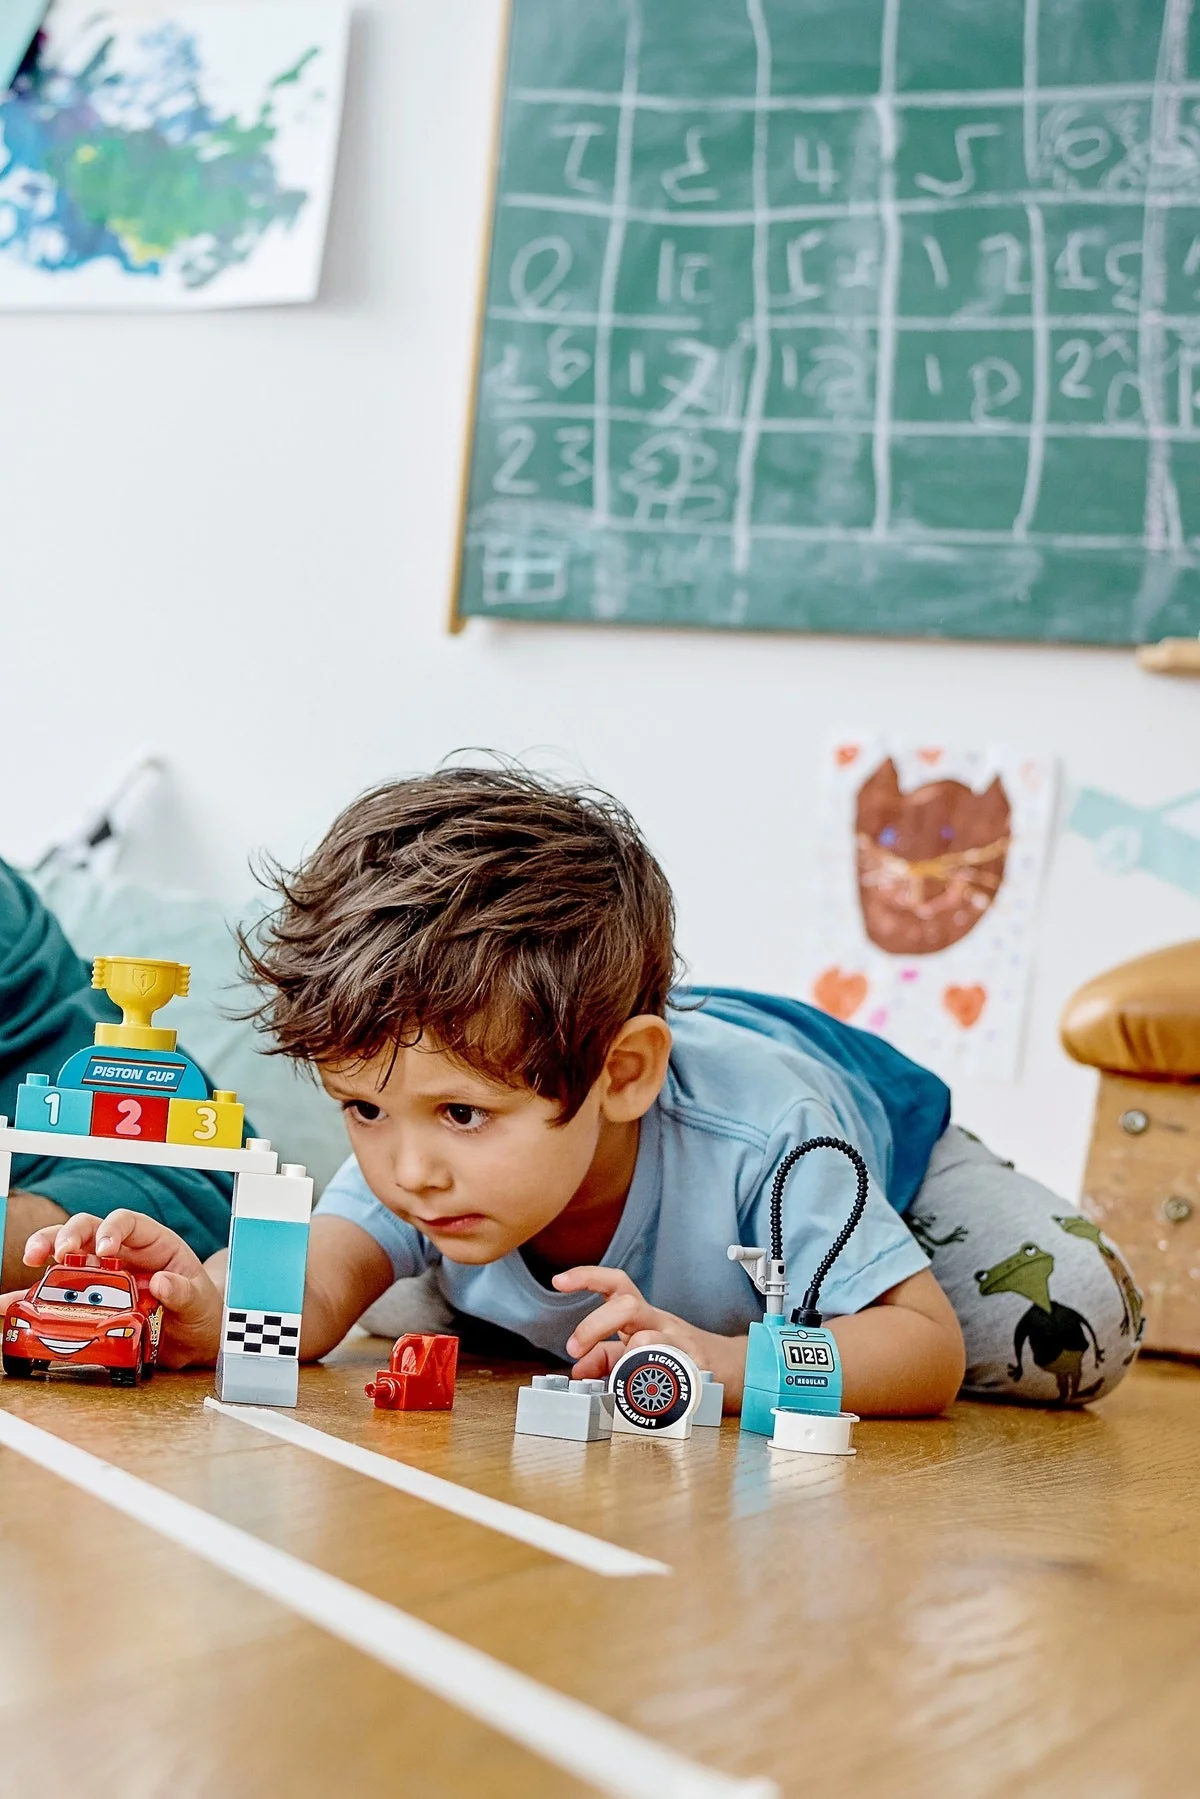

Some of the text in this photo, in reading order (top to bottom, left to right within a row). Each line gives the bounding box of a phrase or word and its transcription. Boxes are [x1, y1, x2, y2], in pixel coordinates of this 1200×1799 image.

[794, 133, 840, 196] 4
[92, 1065, 176, 1083] PISTON CUP
[44, 1092, 218, 1140] 1 2 3
[5, 1329, 19, 1342] 95
[791, 1348, 827, 1363] 123
[648, 1353, 688, 1401] LIGHTYEAR
[616, 1379, 657, 1427] LIGHTYEAR
